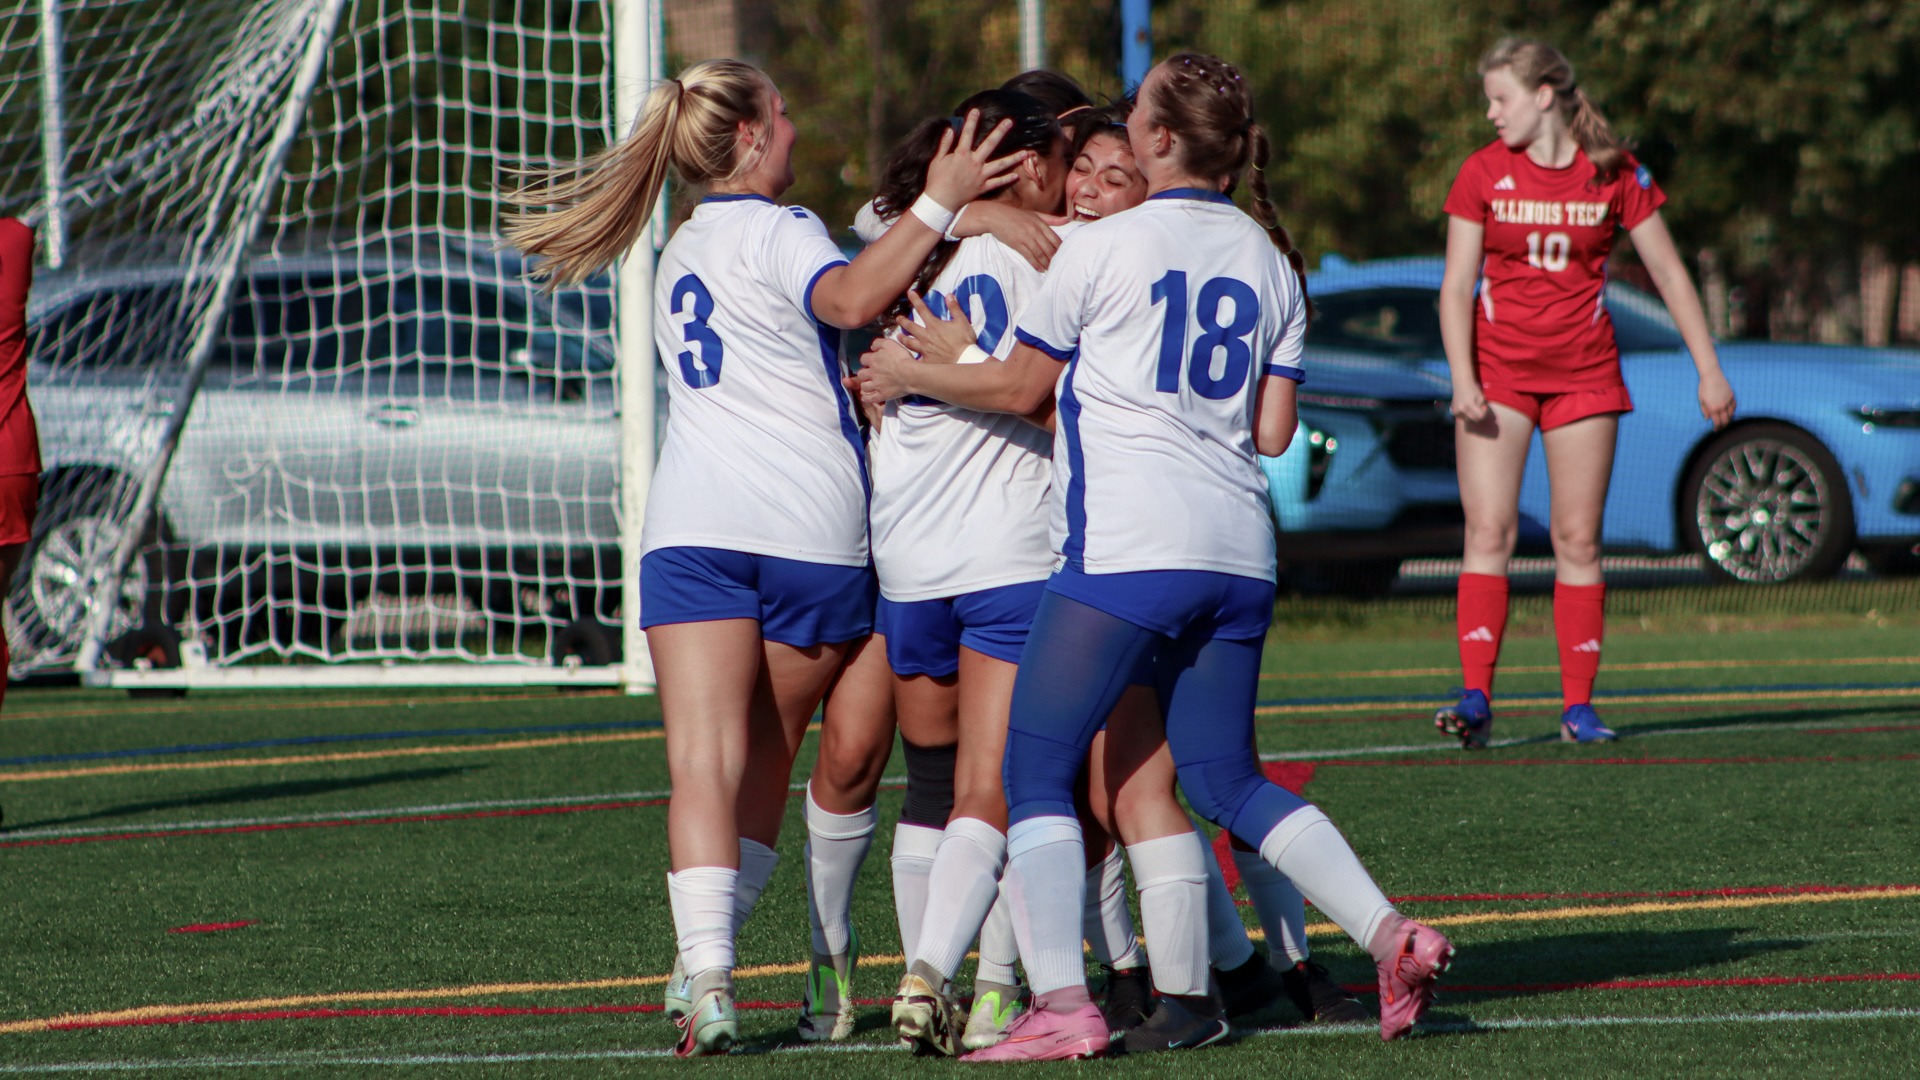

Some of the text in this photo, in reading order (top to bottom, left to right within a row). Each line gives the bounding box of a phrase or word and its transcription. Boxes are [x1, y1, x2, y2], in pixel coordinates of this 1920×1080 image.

[1526, 231, 1570, 272] 10
[671, 273, 724, 389] 3
[1150, 269, 1259, 400] 18
